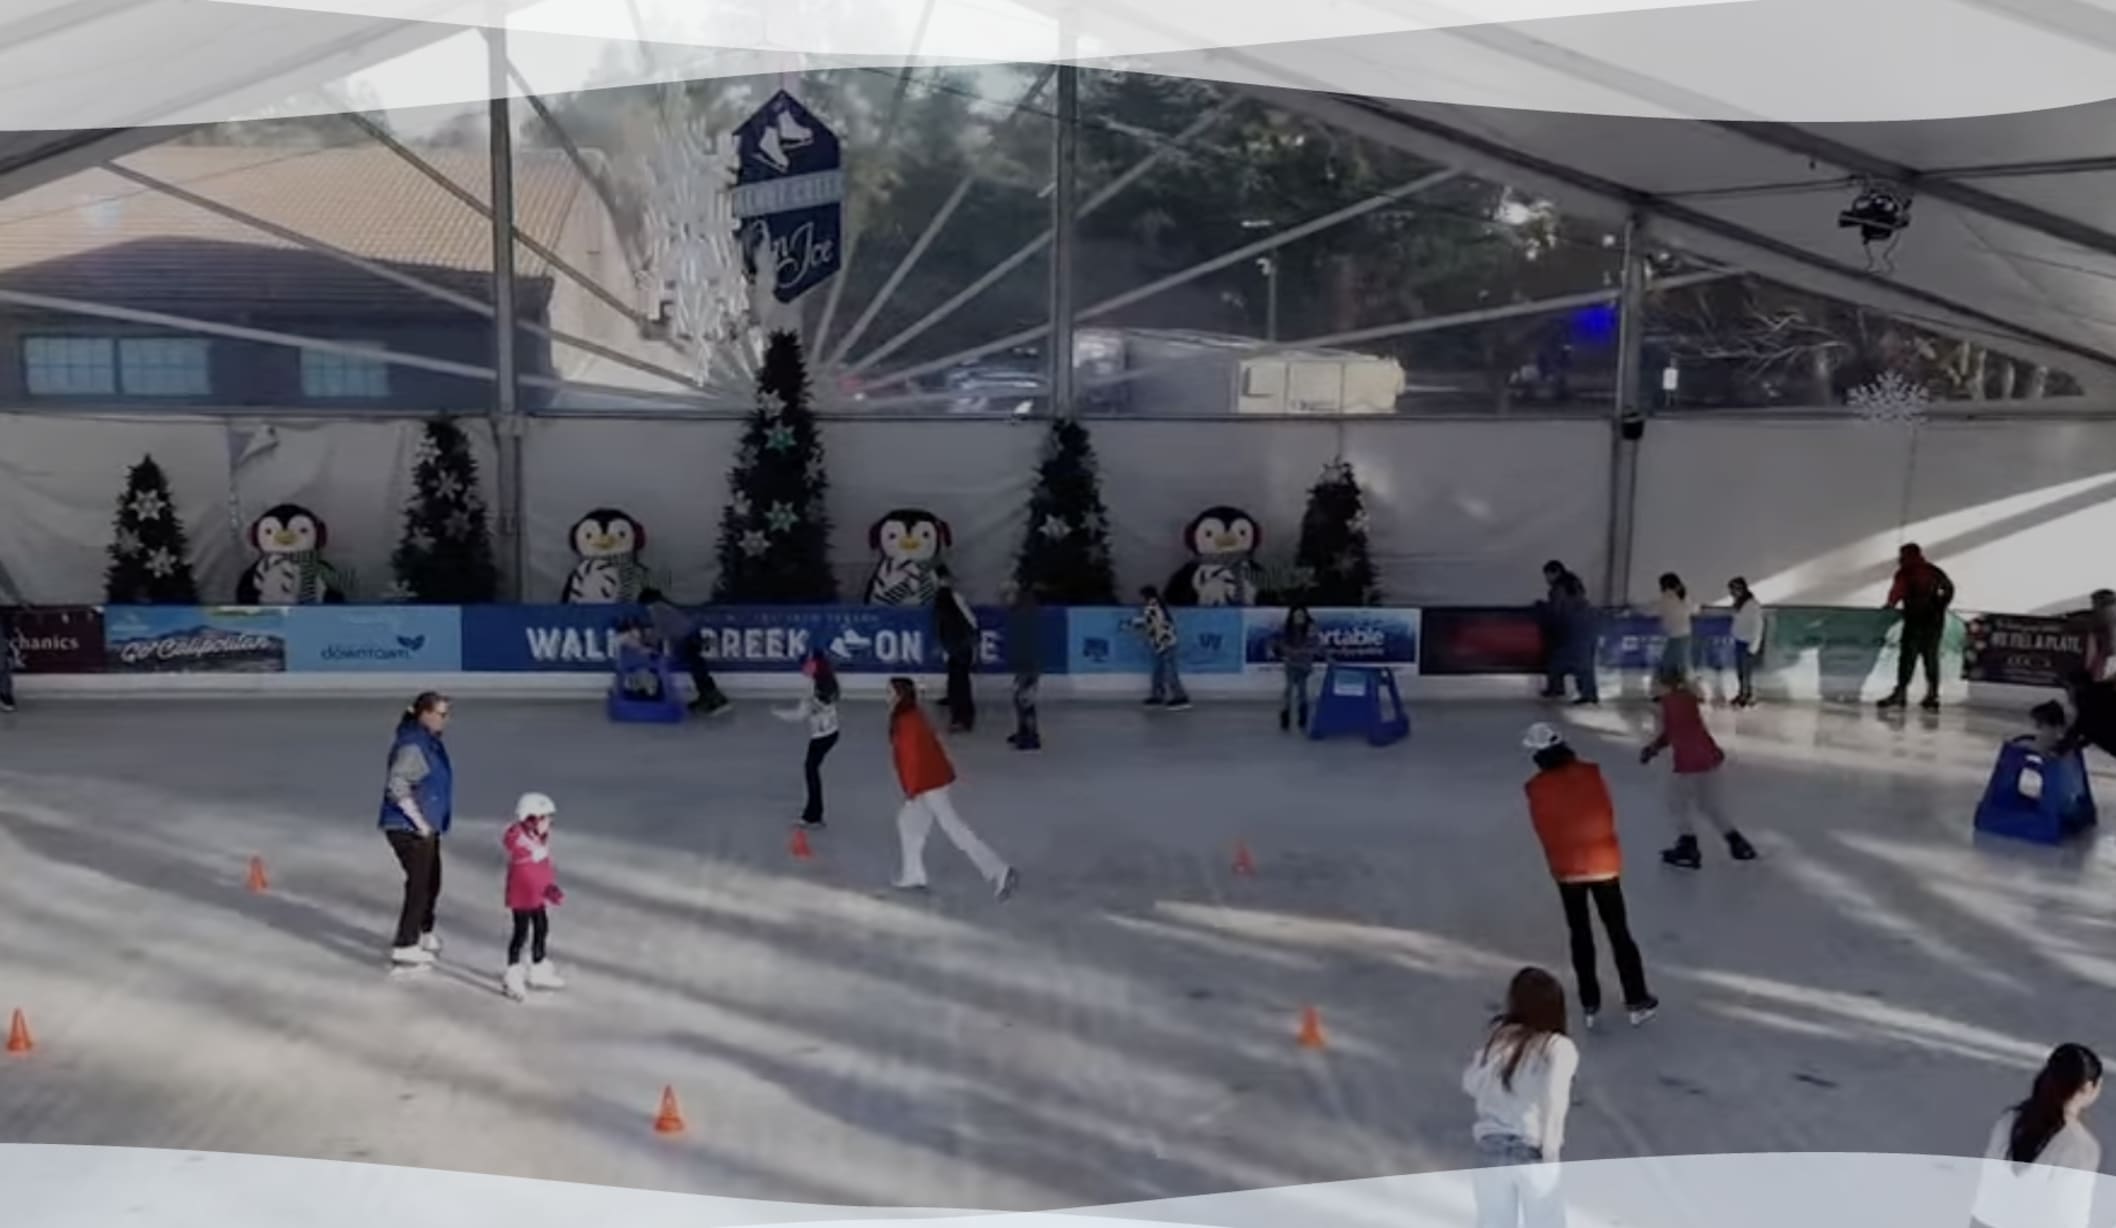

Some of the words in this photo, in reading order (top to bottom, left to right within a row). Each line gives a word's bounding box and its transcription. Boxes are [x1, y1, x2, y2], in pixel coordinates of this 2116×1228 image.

[775, 221, 834, 290] Ice
[10, 632, 80, 651] hanics
[873, 628, 923, 662] ON
[1318, 627, 1385, 647] rtable
[321, 644, 411, 660] downtown
